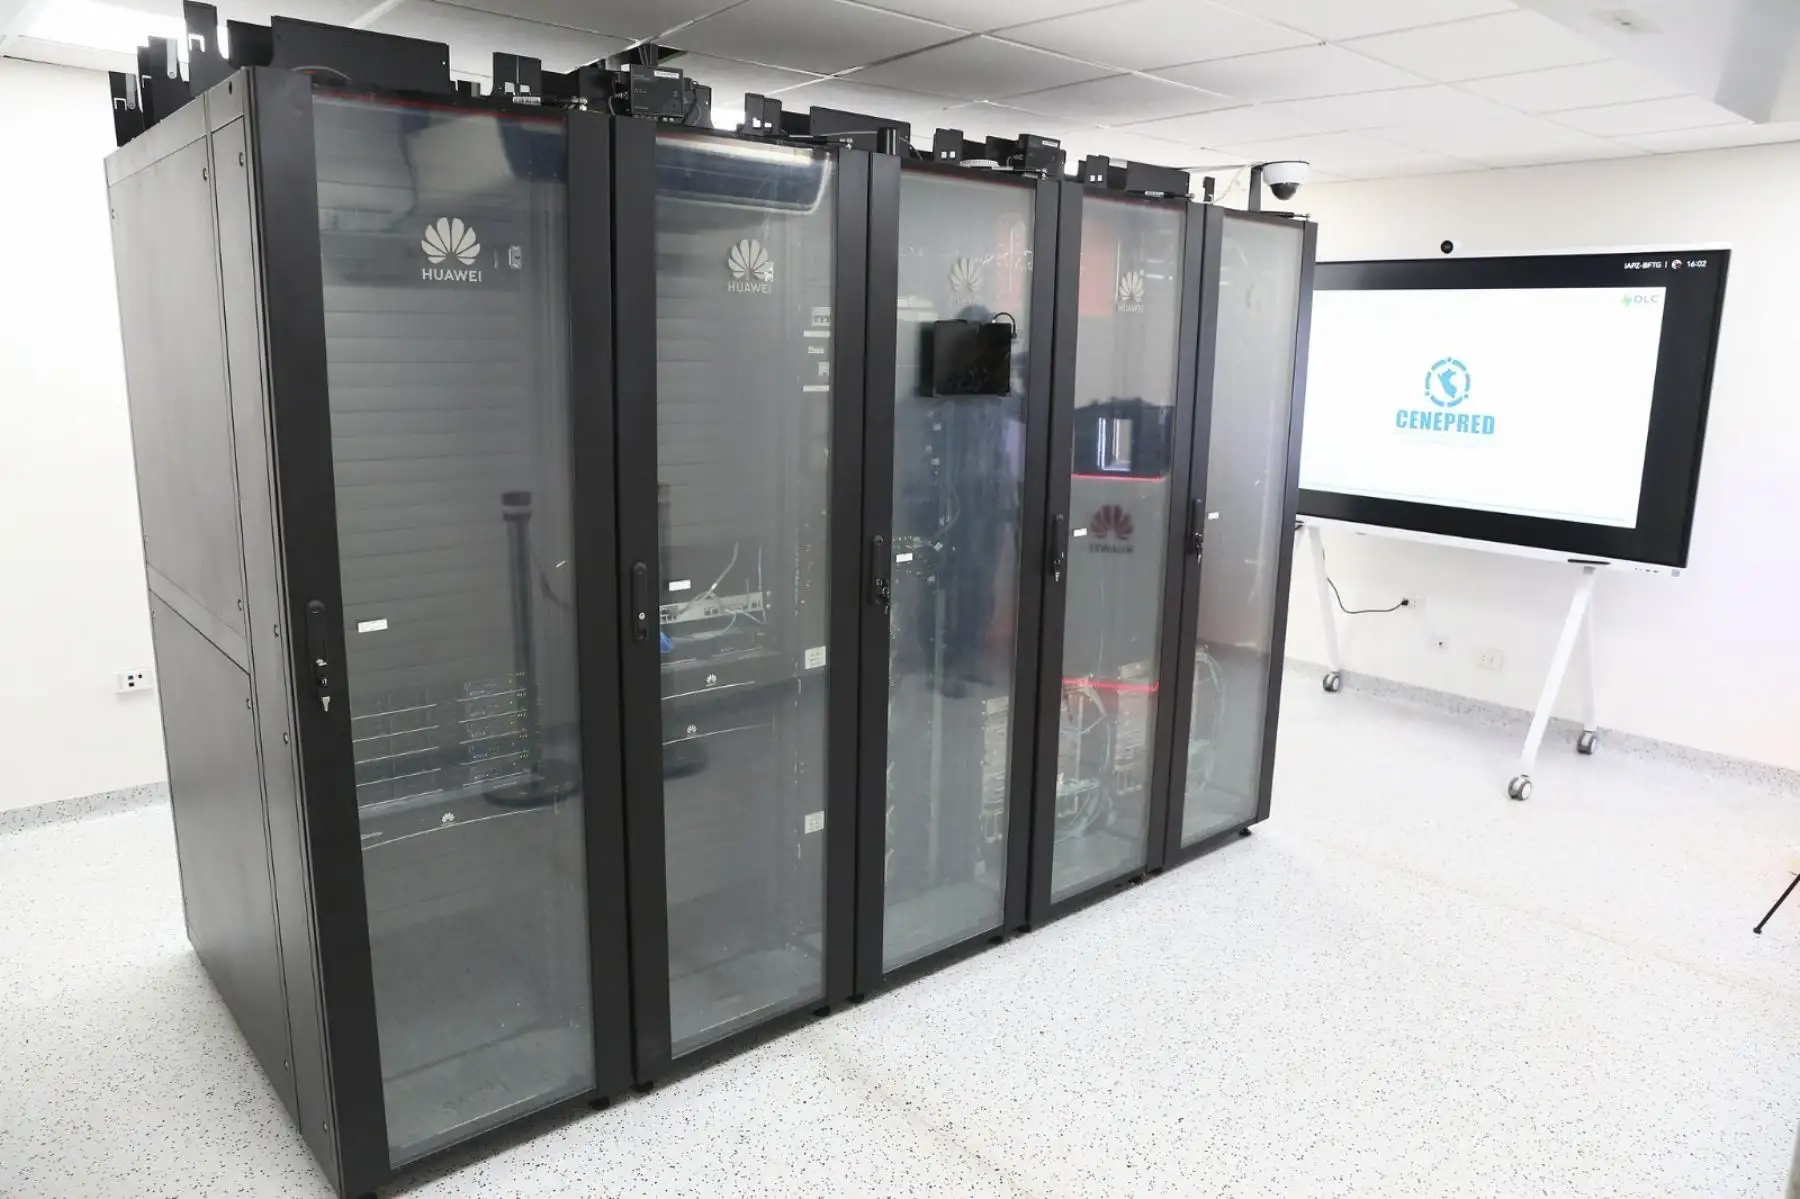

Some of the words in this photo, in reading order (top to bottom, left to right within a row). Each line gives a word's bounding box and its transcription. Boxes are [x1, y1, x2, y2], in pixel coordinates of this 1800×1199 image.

[1686, 259, 1707, 268] 16:02
[421, 268, 482, 283] HUAWEI
[727, 281, 772, 294] HUAWEI
[1395, 409, 1495, 434] CENEPRED
